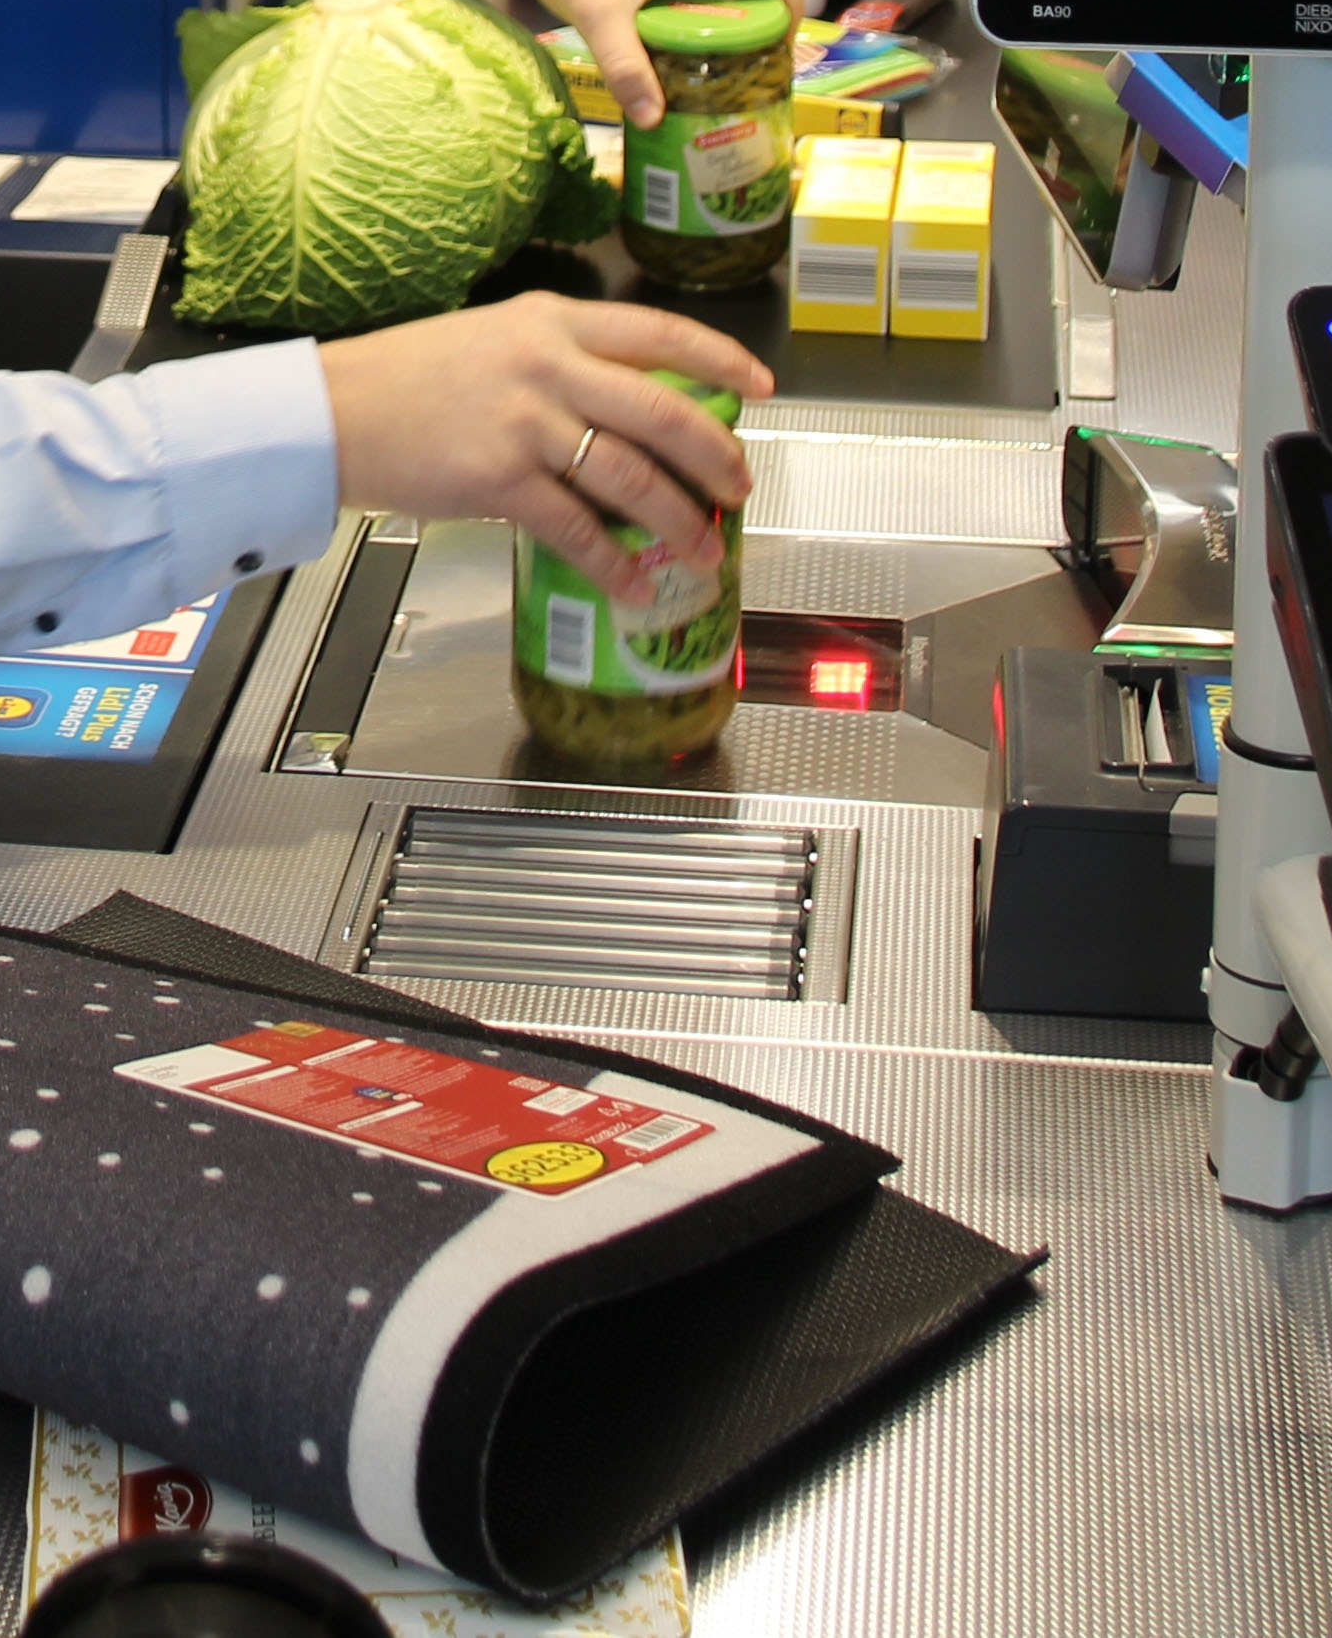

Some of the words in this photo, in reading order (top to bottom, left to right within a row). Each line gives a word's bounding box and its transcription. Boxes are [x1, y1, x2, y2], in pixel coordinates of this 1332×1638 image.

[1032, 4, 1072, 18] BA90
[55, 686, 99, 739] GEFRAGT?
[96, 686, 133, 712] Lidl
[125, 682, 159, 718] SCHON
[80, 713, 119, 742] Plus
[108, 719, 143, 750] NACH
[493, 1141, 598, 1184] 362533
